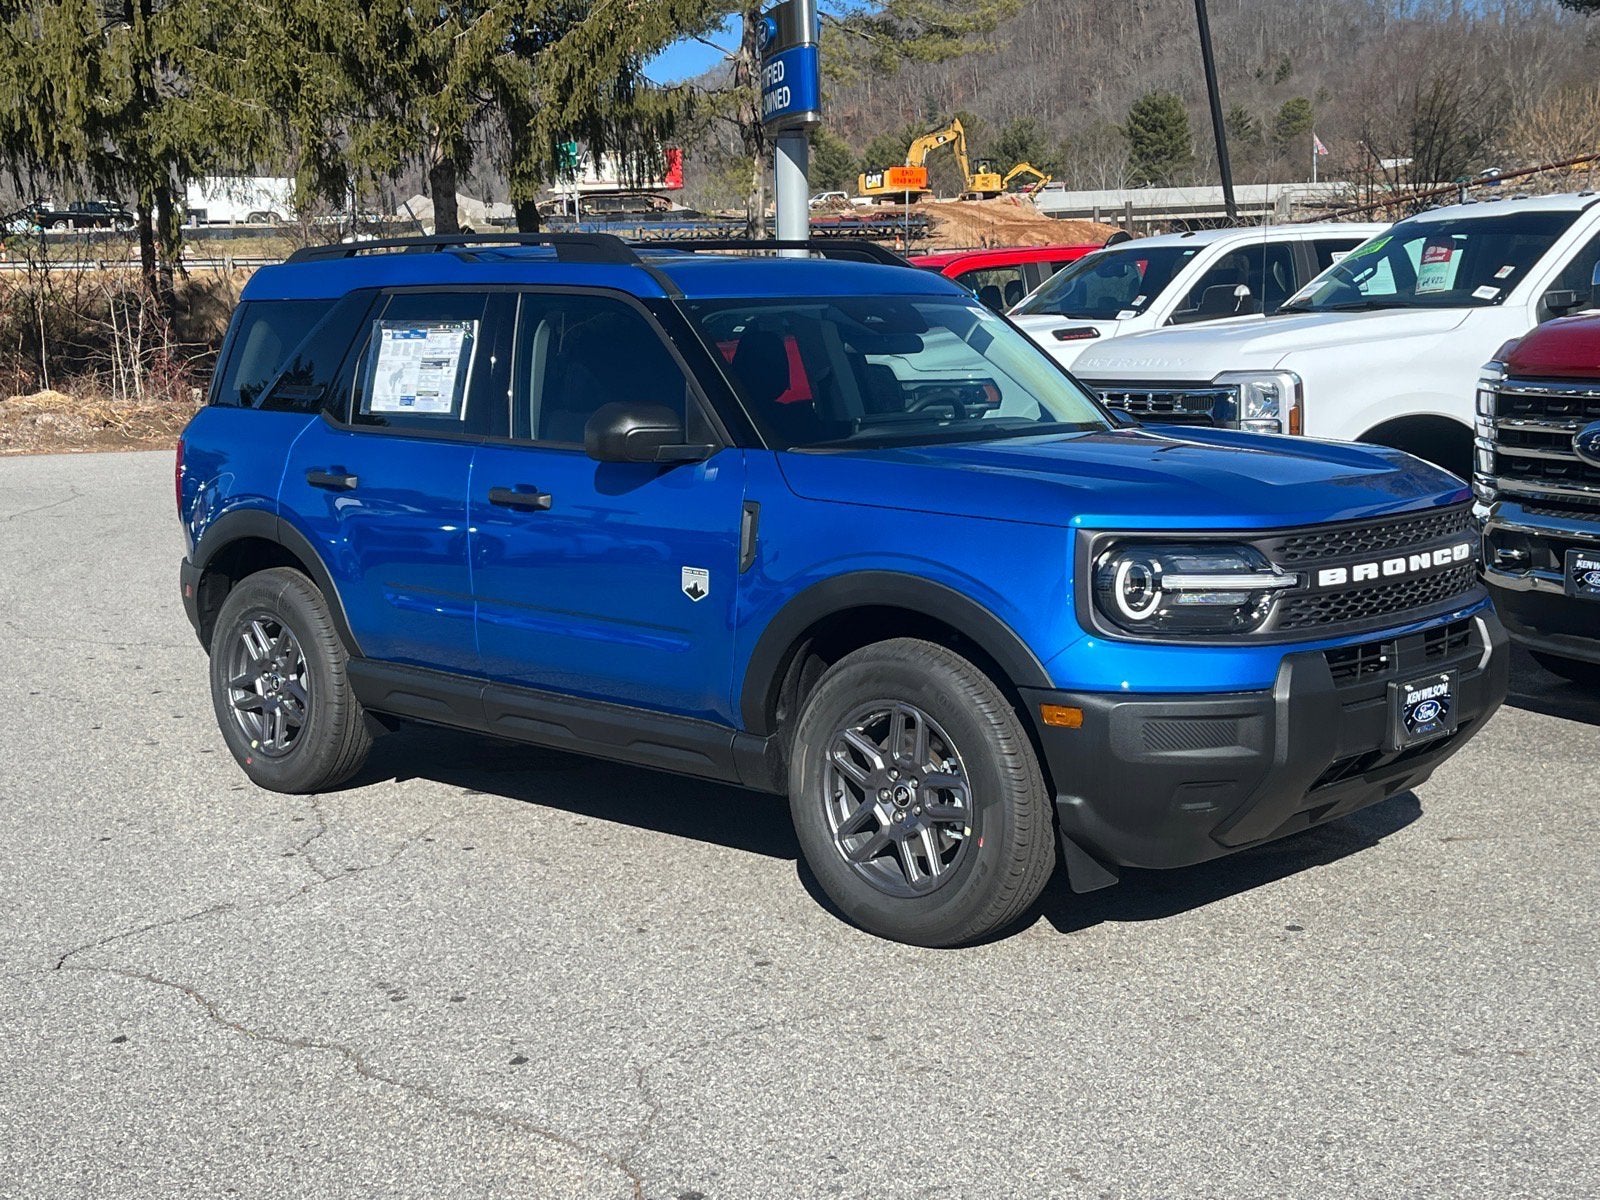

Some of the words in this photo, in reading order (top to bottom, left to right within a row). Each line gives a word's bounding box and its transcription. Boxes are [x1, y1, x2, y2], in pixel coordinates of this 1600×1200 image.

[866, 174, 882, 189] CAT
[1318, 543, 1470, 587] BRONCO
[1406, 689, 1422, 705] KEN
[1421, 682, 1448, 701] WILSON
[1418, 703, 1436, 720] Ford
